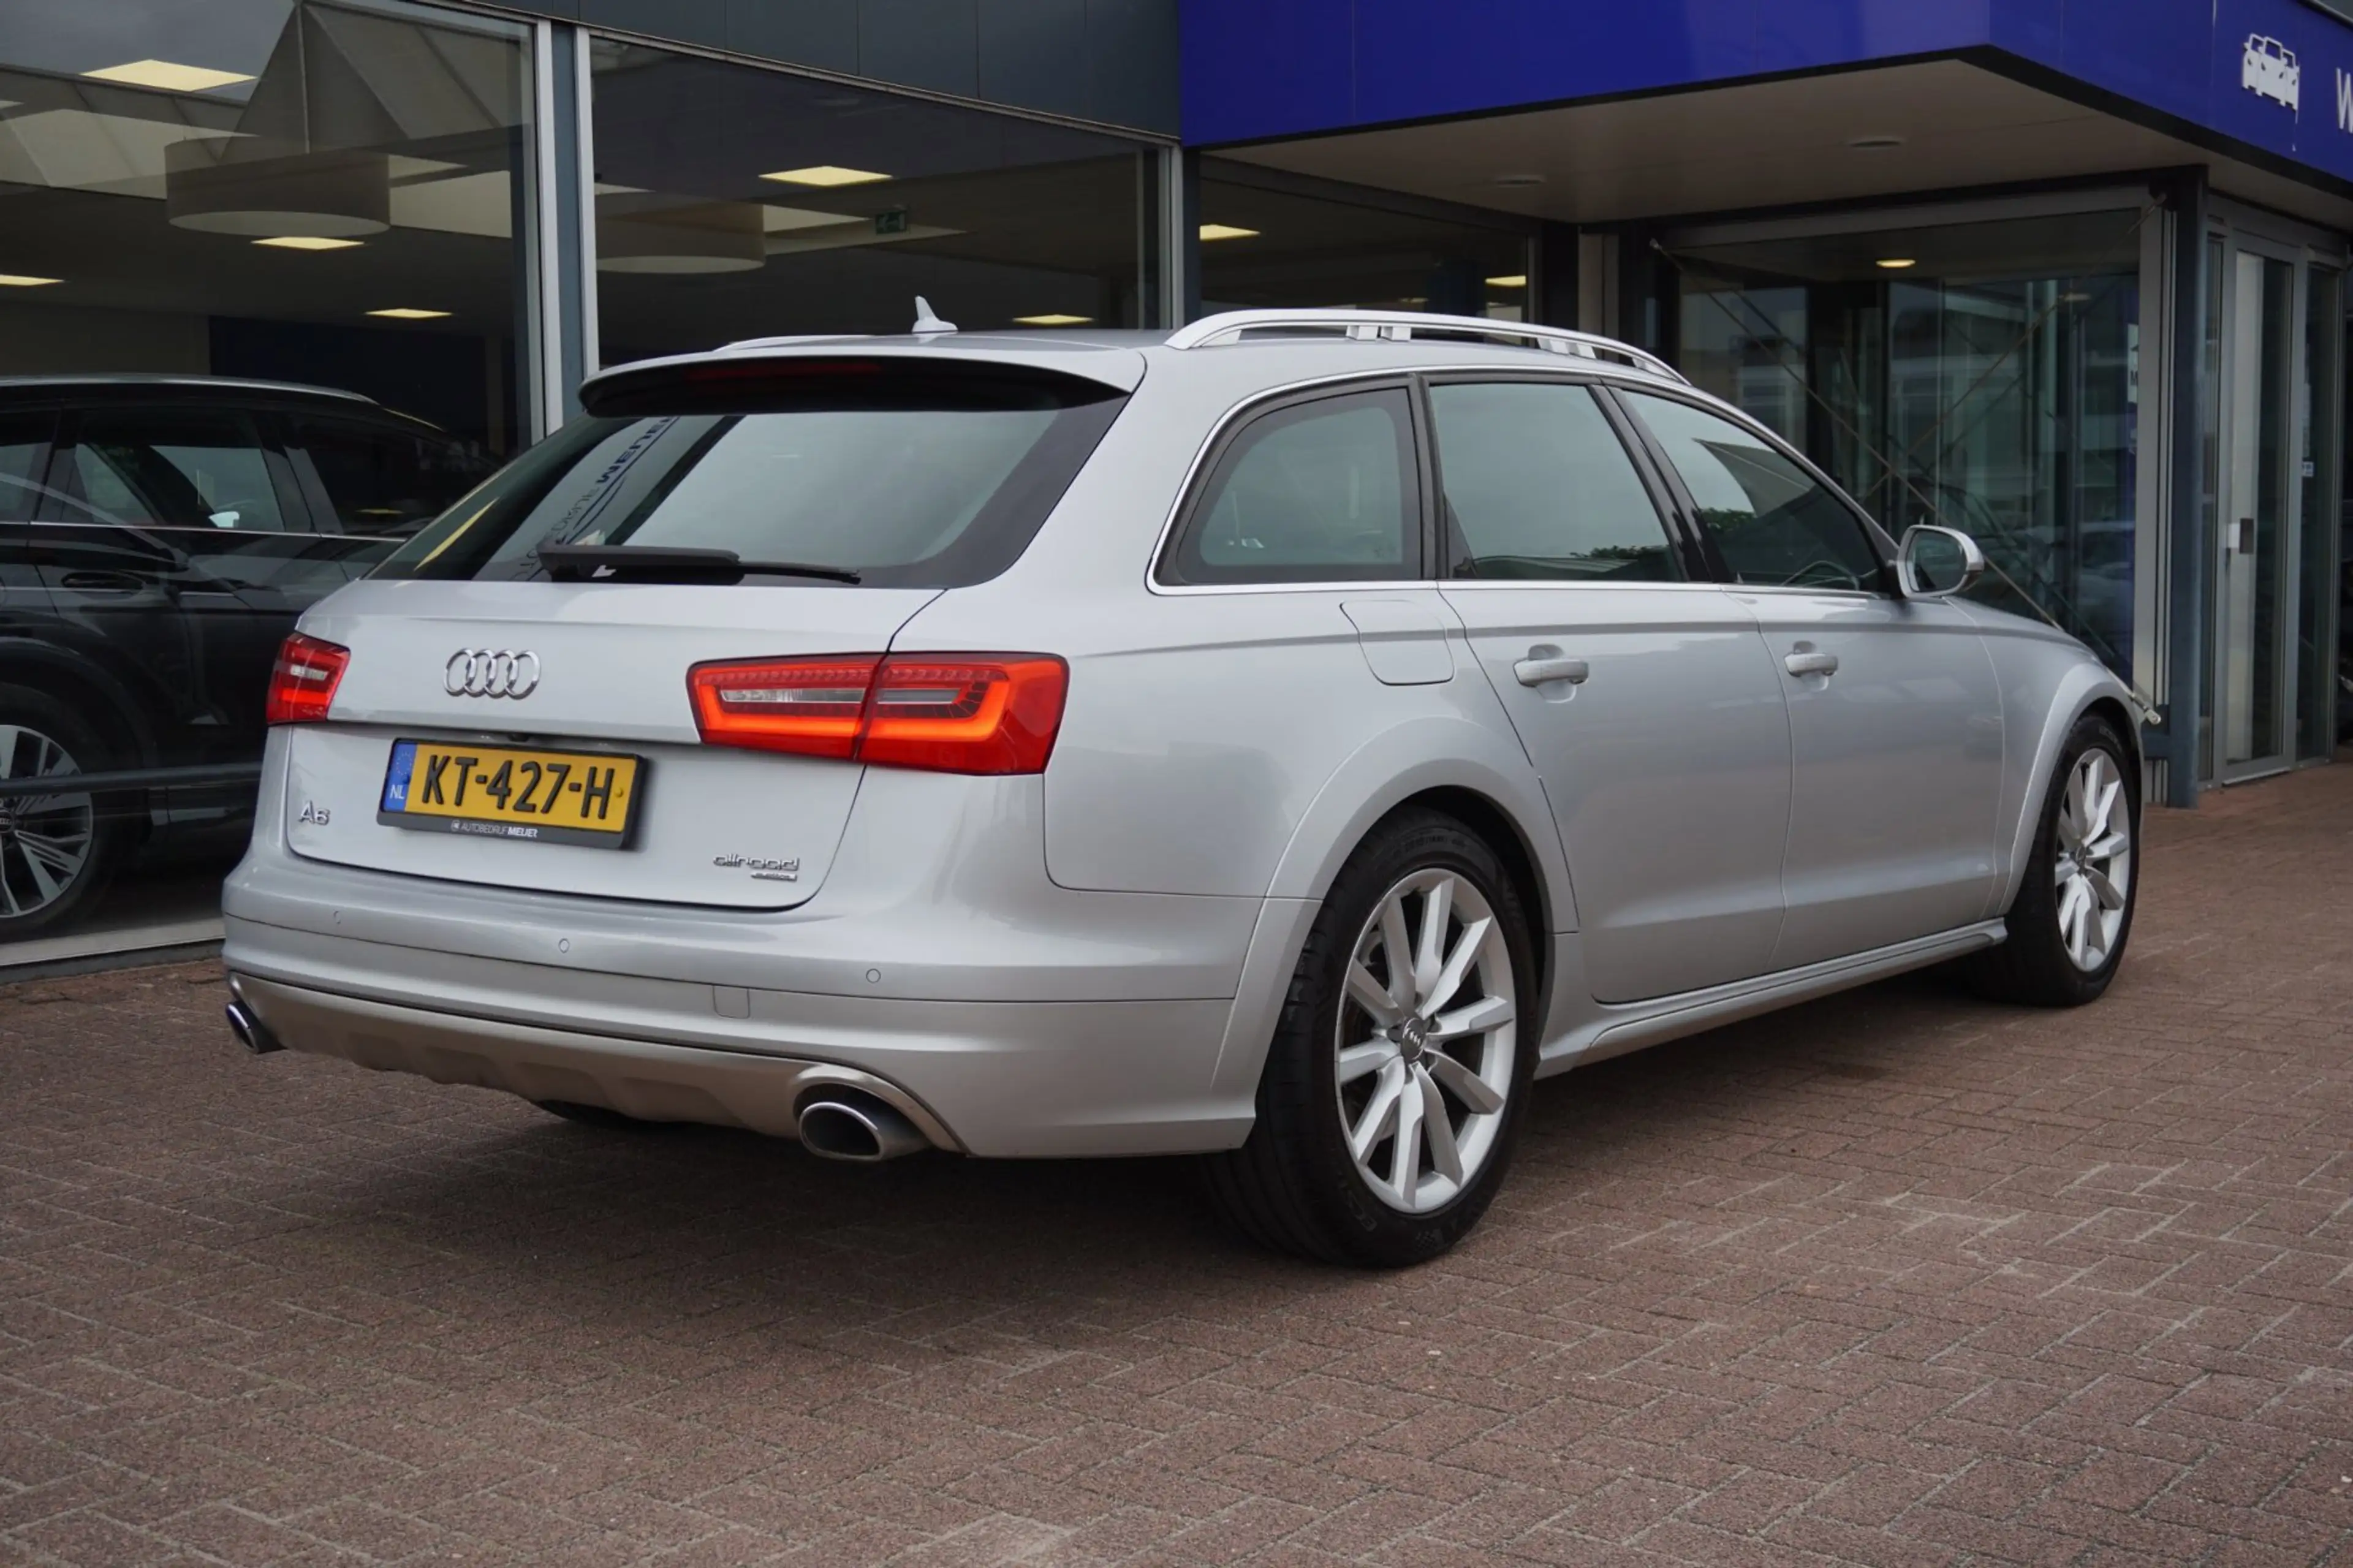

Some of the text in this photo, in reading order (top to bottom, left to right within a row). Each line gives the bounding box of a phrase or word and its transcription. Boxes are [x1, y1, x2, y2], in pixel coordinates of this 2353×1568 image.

[390, 784, 405, 800] NL
[421, 754, 615, 820] KT-427-H
[298, 800, 331, 825] A6
[507, 826, 539, 838] MEIJER
[713, 854, 800, 871] allroad
